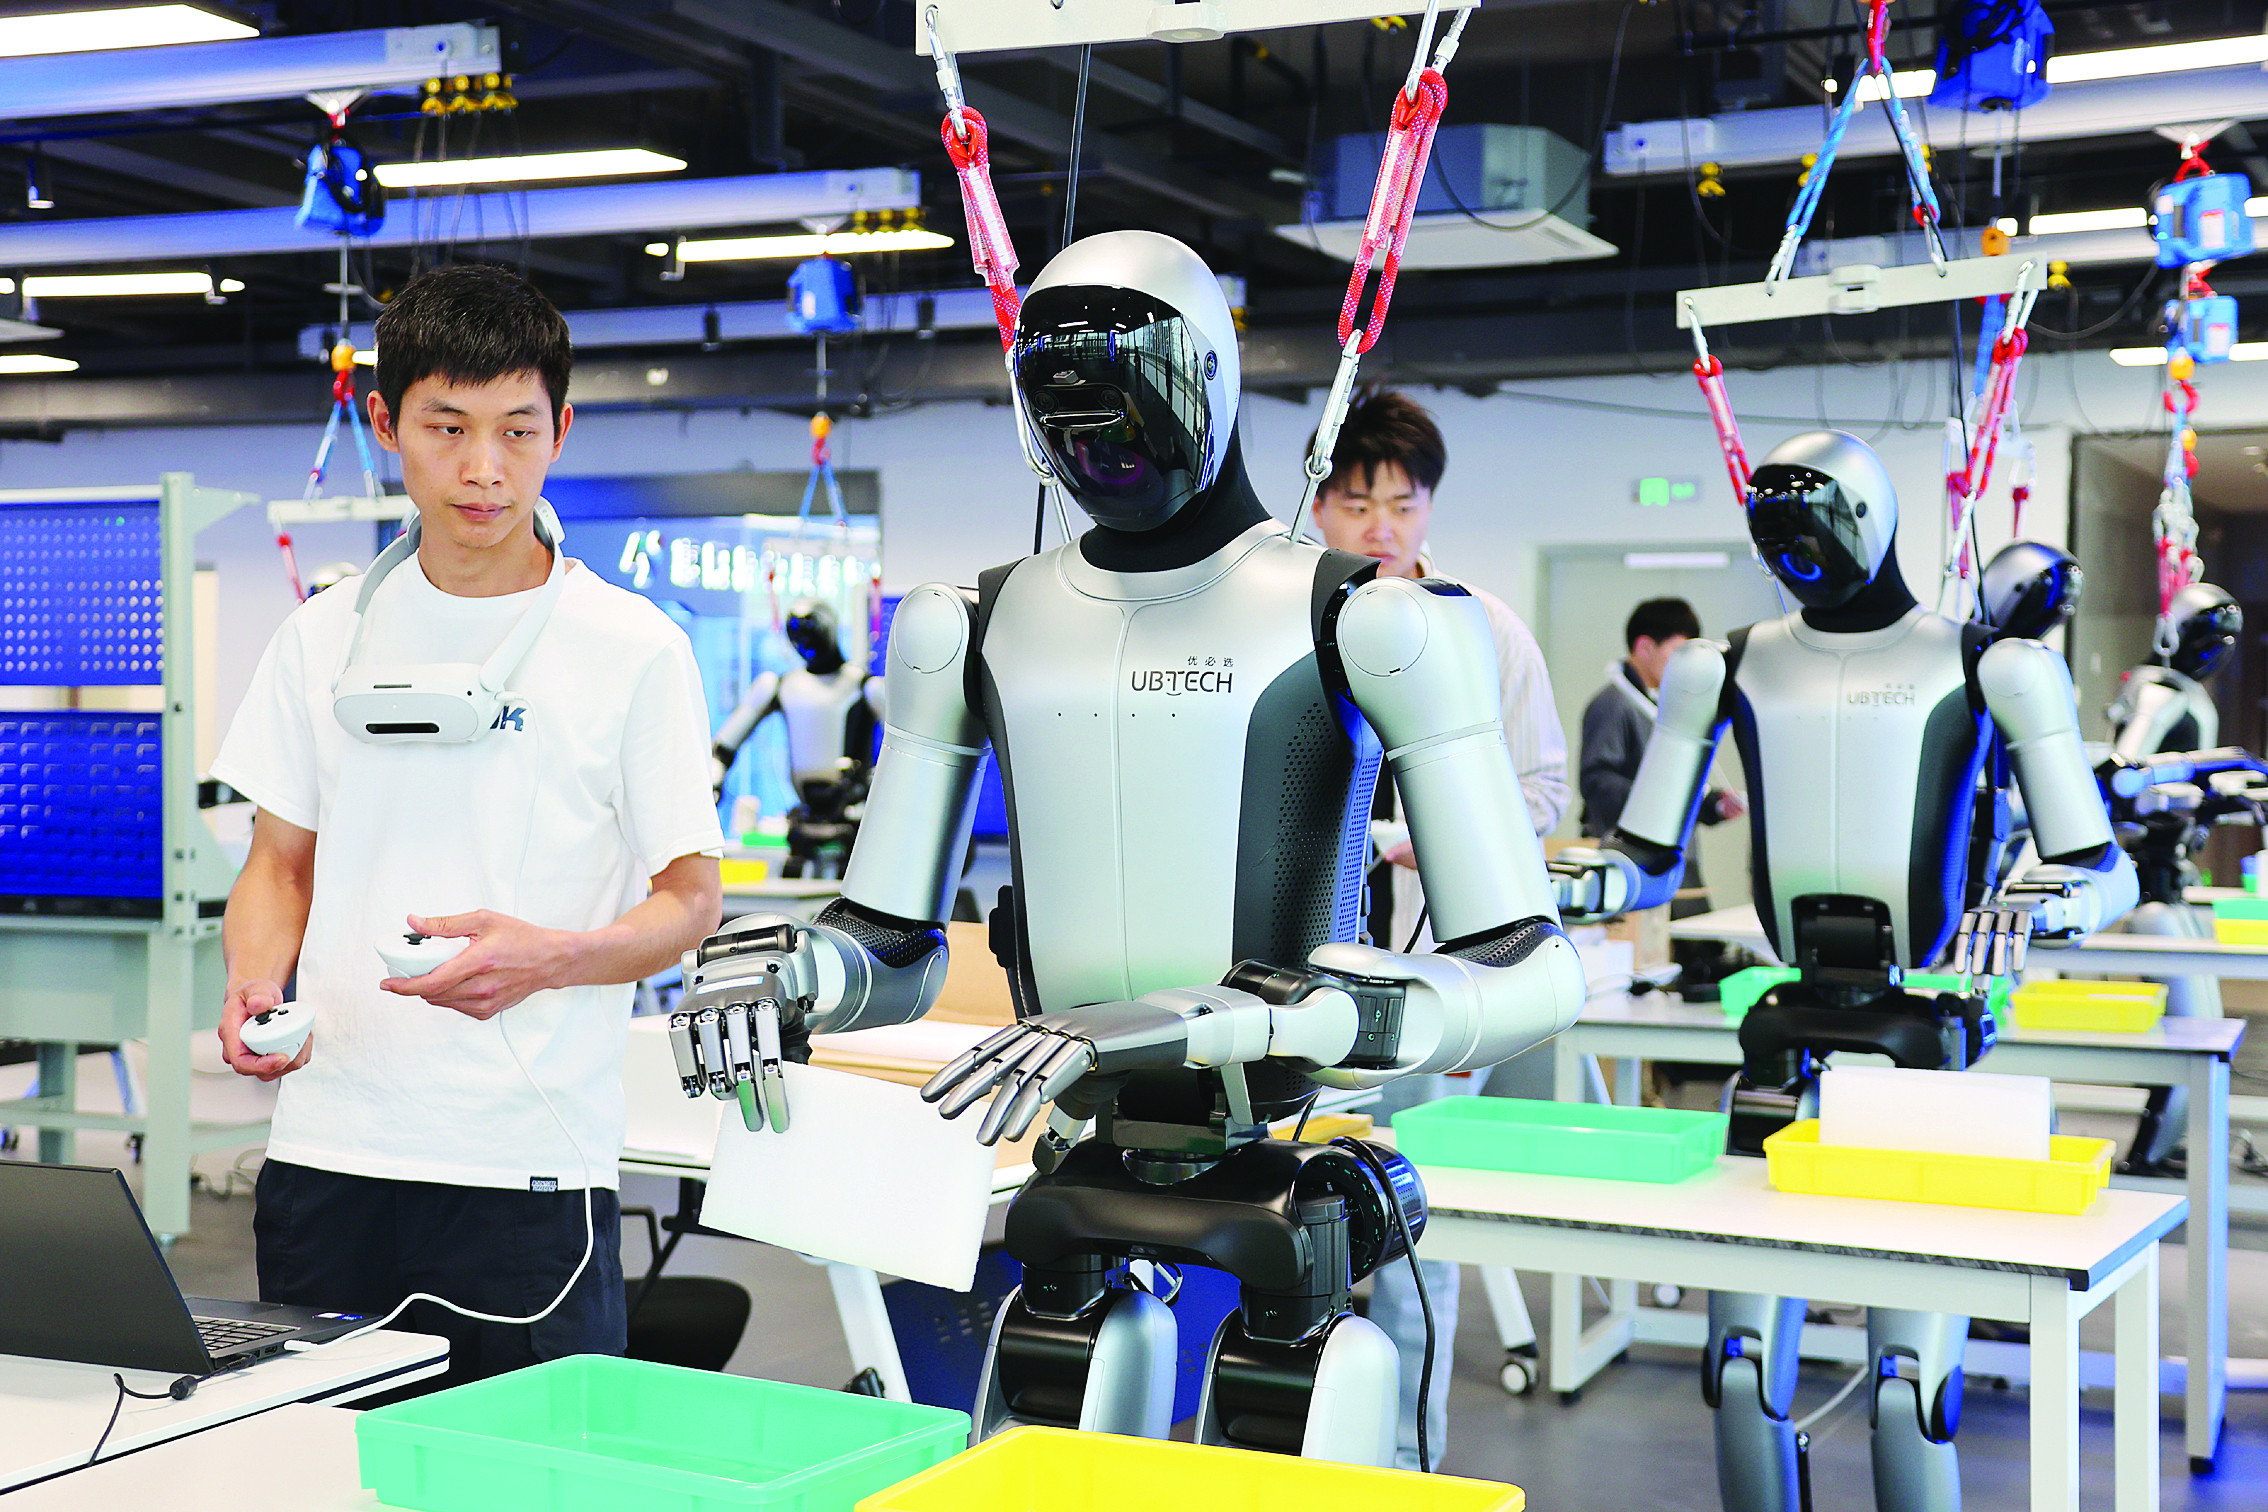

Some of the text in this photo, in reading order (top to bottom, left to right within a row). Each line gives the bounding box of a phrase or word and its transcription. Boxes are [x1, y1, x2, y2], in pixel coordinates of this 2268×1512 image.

[1187, 655, 1234, 667] 优必选
[1131, 670, 1233, 696] UBTECH
[1847, 691, 1915, 706] UBTECH
